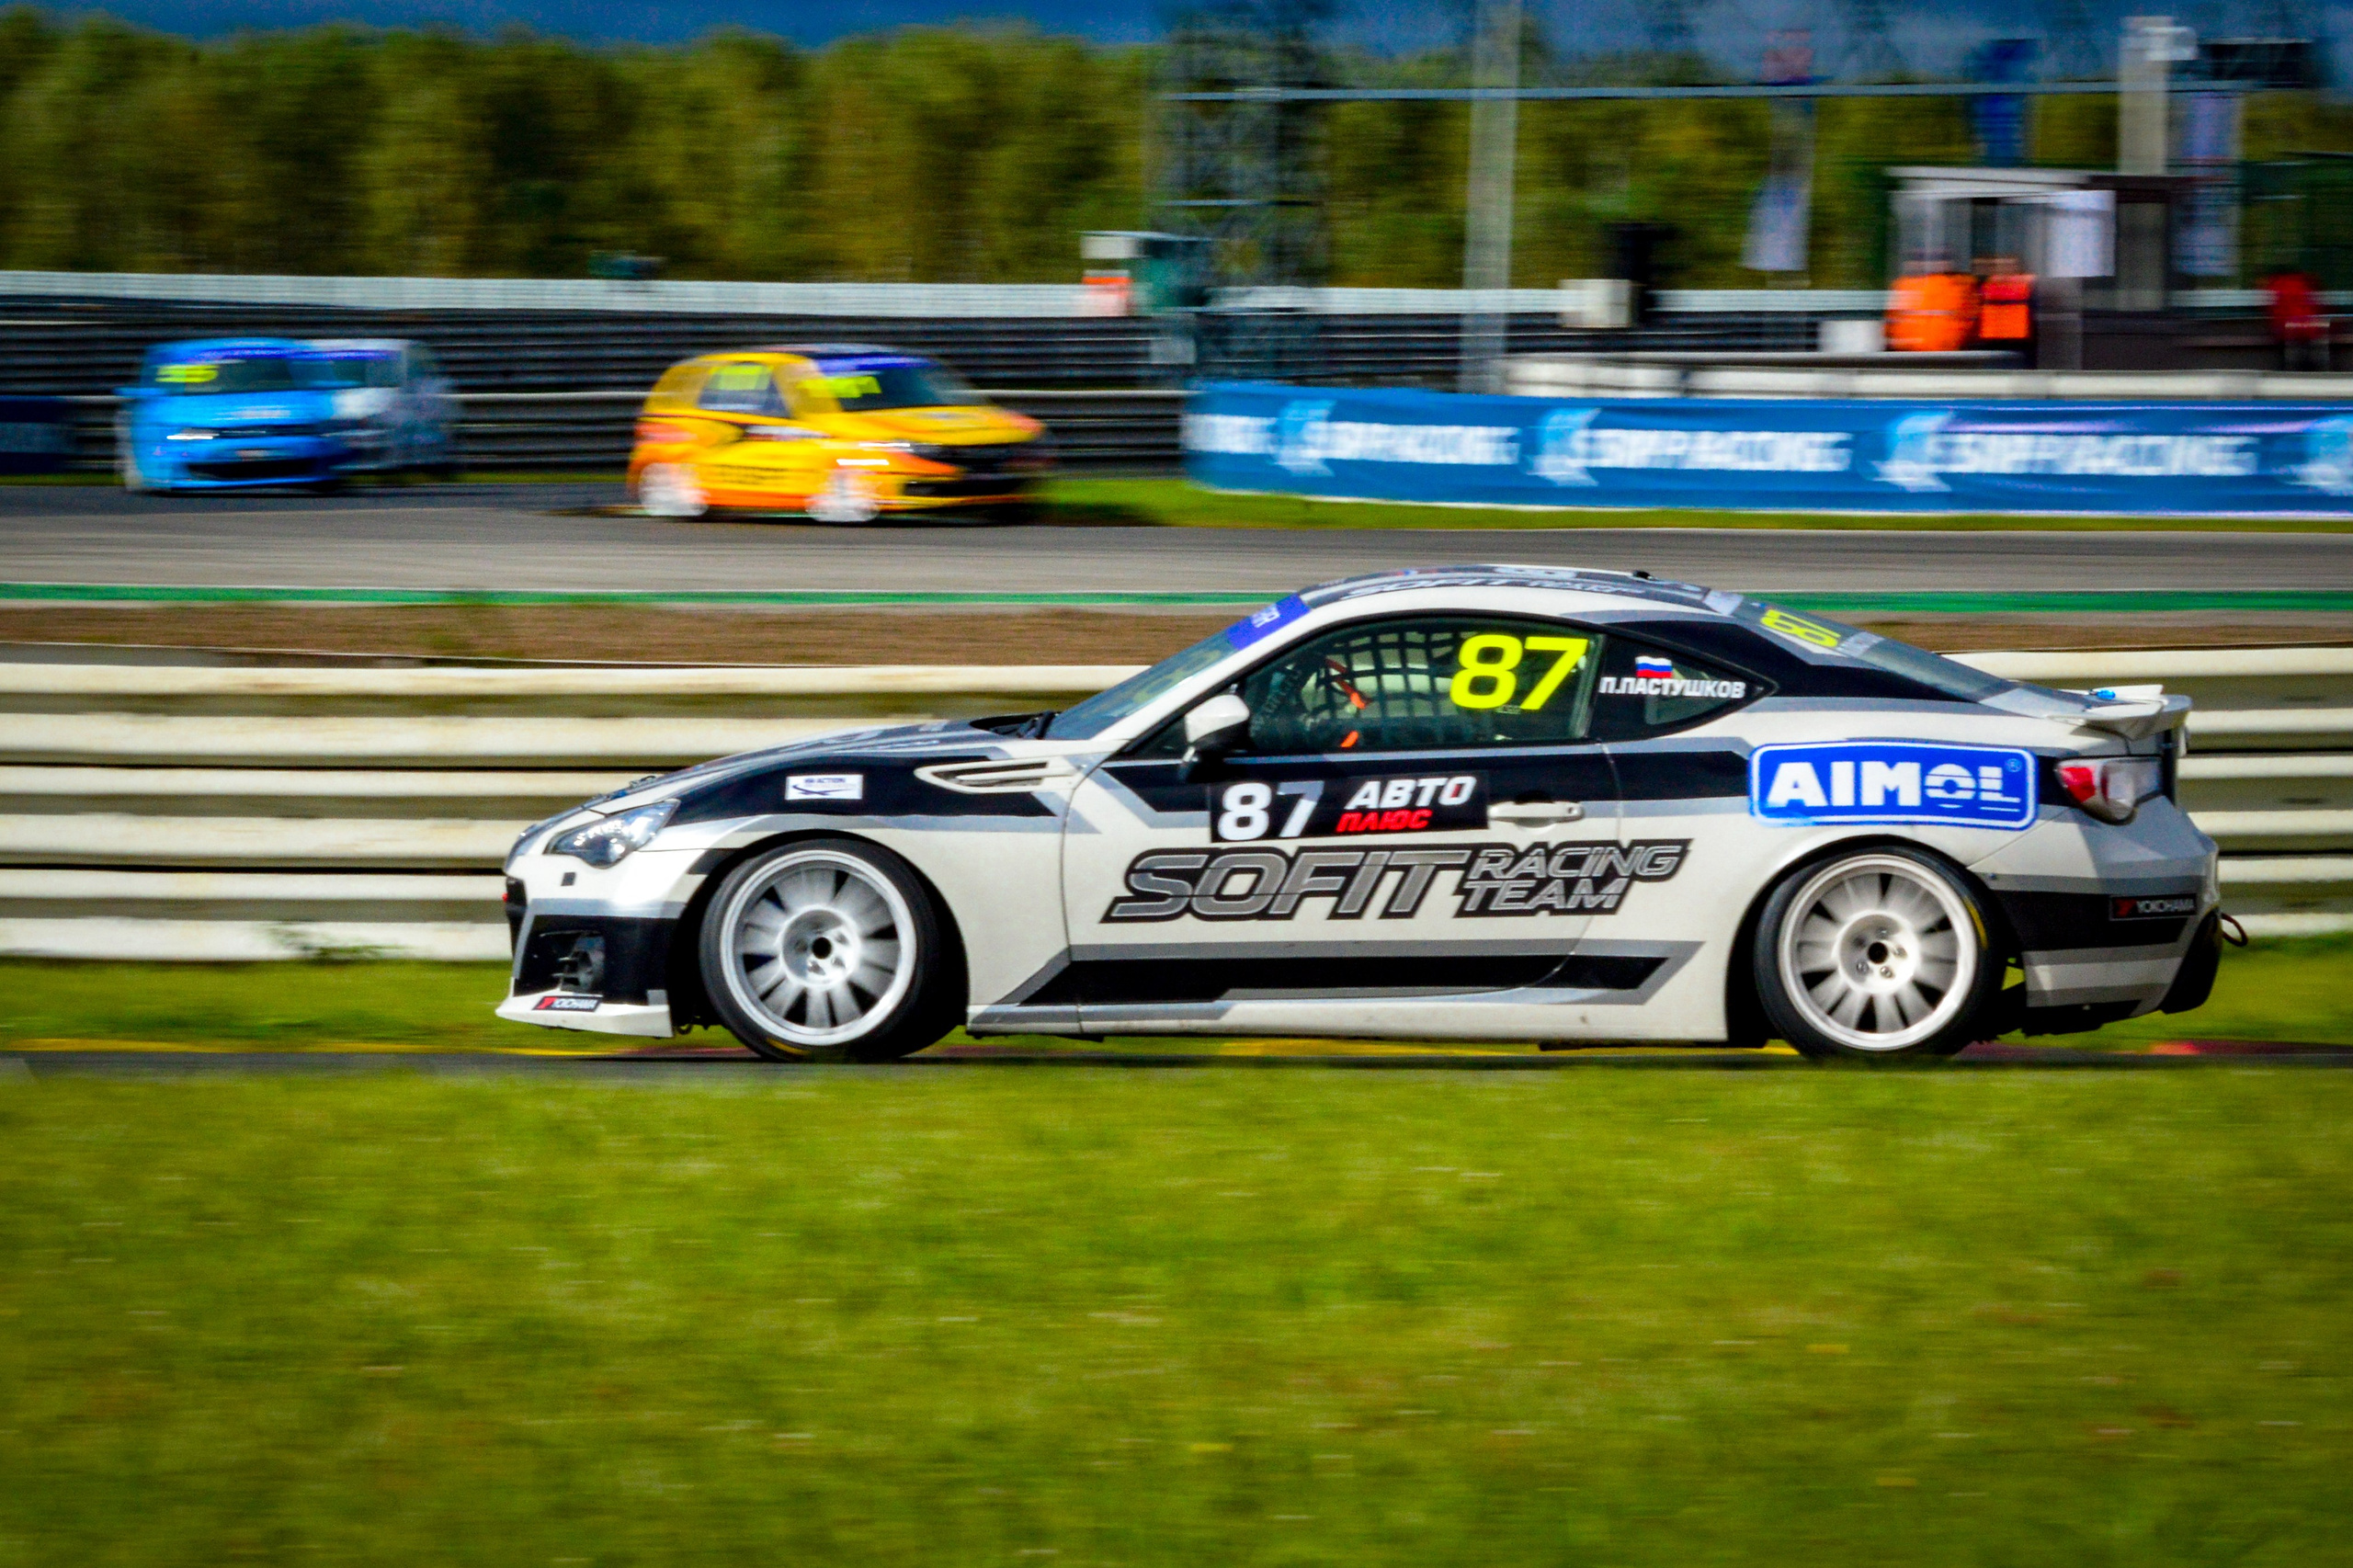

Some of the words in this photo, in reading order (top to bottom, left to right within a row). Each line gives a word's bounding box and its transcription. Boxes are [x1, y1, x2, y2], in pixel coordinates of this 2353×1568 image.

[1449, 634, 1589, 710] 87
[1218, 781, 1324, 841] 87
[1344, 776, 1477, 810] АВТО
[1766, 761, 2022, 812] AIMOL
[1336, 809, 1433, 832] ПЛЮС
[1107, 847, 1473, 918] SOFIT
[1466, 844, 1685, 880] RACING
[1462, 878, 1632, 913] TEAM
